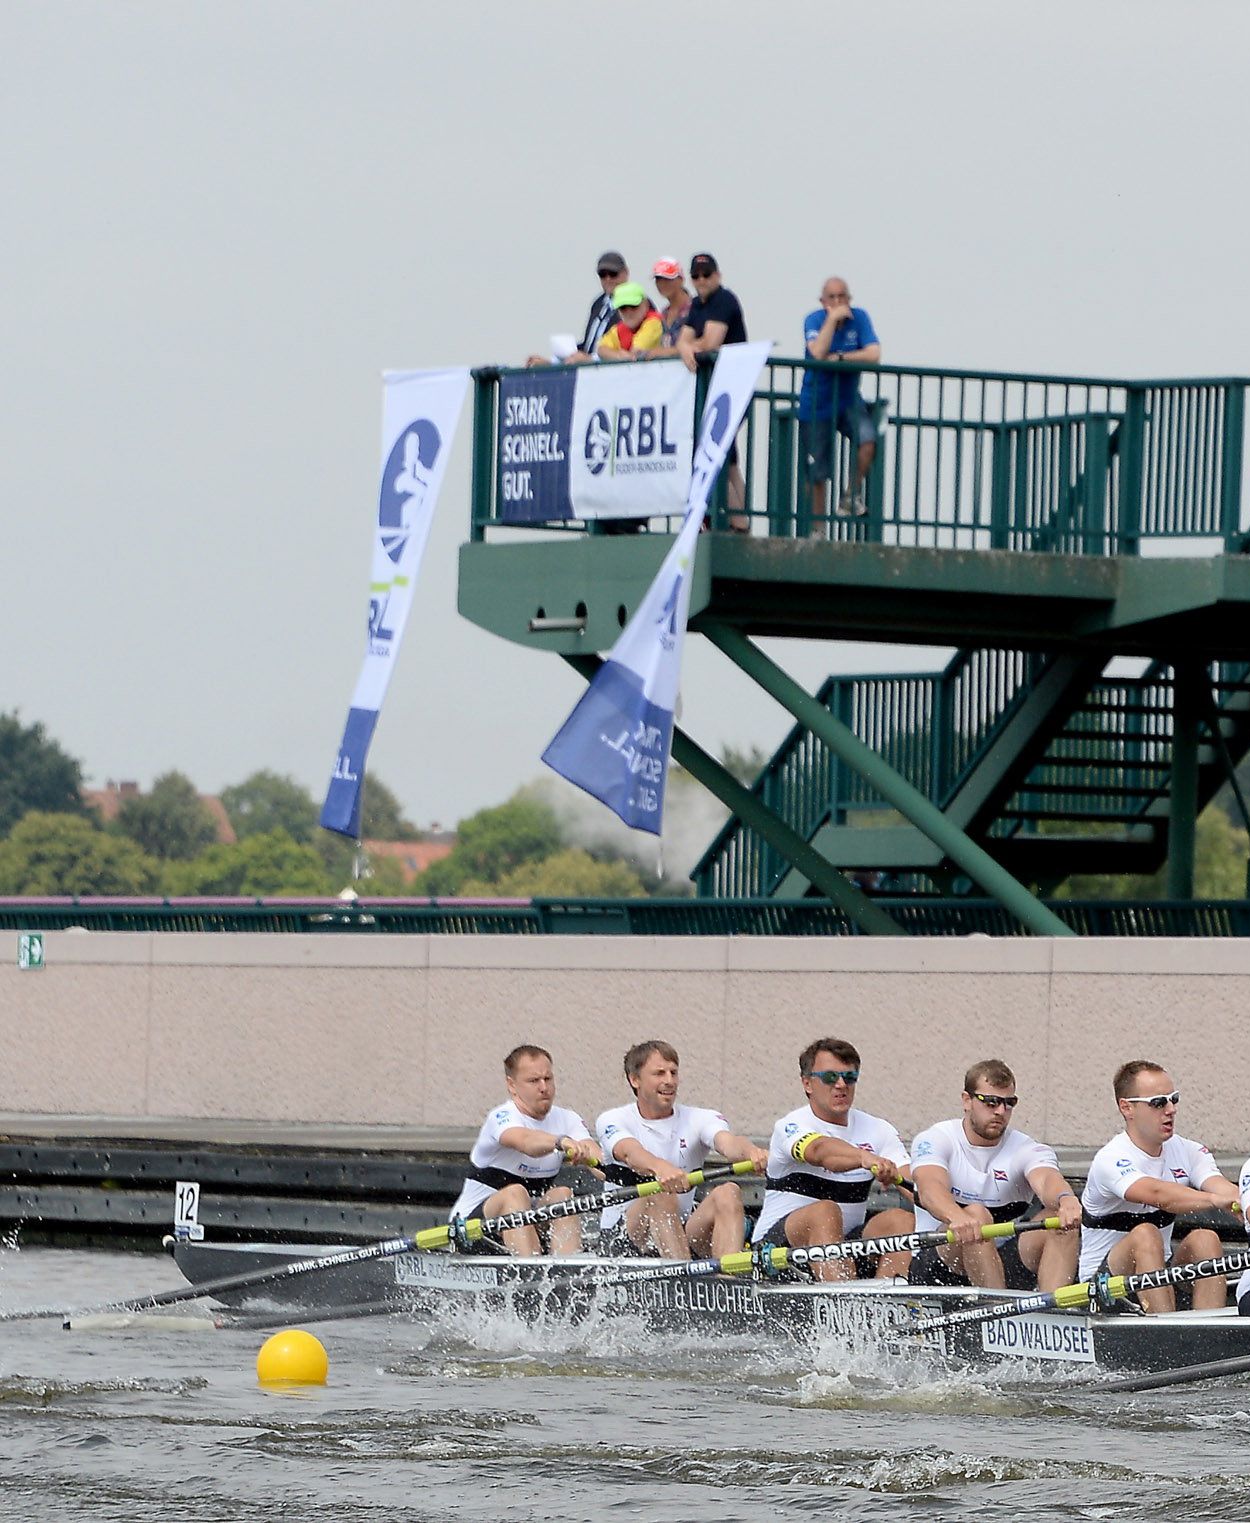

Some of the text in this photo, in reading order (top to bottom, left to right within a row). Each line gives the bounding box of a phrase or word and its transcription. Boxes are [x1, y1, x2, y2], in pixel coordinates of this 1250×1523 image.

[504, 395, 550, 427] STARK.
[502, 431, 565, 463] SCHNELL.
[617, 405, 677, 457] RBL
[503, 471, 534, 500] GUT.
[179, 1187, 195, 1220] 12
[287, 1259, 318, 1274] STARK.
[359, 1247, 380, 1259] GUT.
[384, 1239, 408, 1253] RBL
[840, 1234, 920, 1258] FRANKE
[664, 1266, 685, 1276] GUT.
[690, 1262, 713, 1273] RBL
[917, 1317, 949, 1330] STARK.
[950, 1308, 993, 1321] SCHNELL.
[993, 1303, 1015, 1315] GUT.
[1020, 1297, 1046, 1308] RBL
[987, 1319, 1089, 1354] BAD WALDSEE
